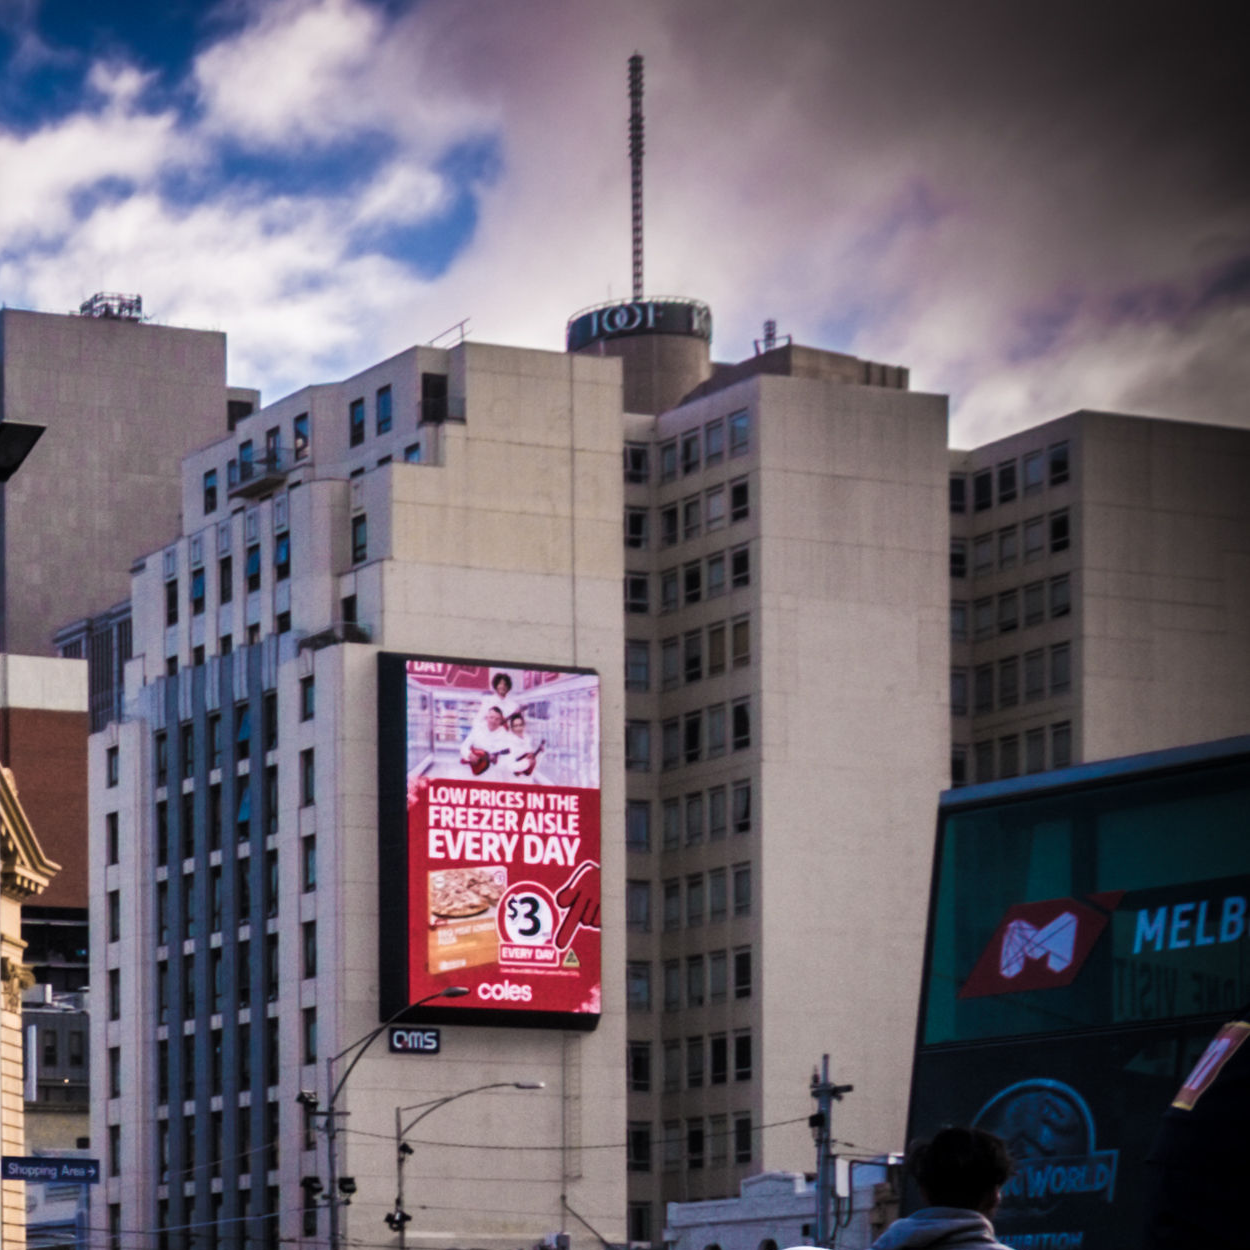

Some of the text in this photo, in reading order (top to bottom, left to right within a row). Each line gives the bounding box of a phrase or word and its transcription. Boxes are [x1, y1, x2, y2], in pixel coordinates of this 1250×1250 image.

[428, 787, 579, 812] LOW PRICES IN THE
[428, 805, 579, 835] FREEZER AISLE
[428, 829, 581, 866] EVERY DAY
[1132, 896, 1250, 955] MELB
[501, 947, 556, 961] EVERY DAY
[477, 979, 533, 1001] coles
[8, 1162, 86, 1180] Shopping Area
[1025, 1160, 1112, 1198] WORLD
